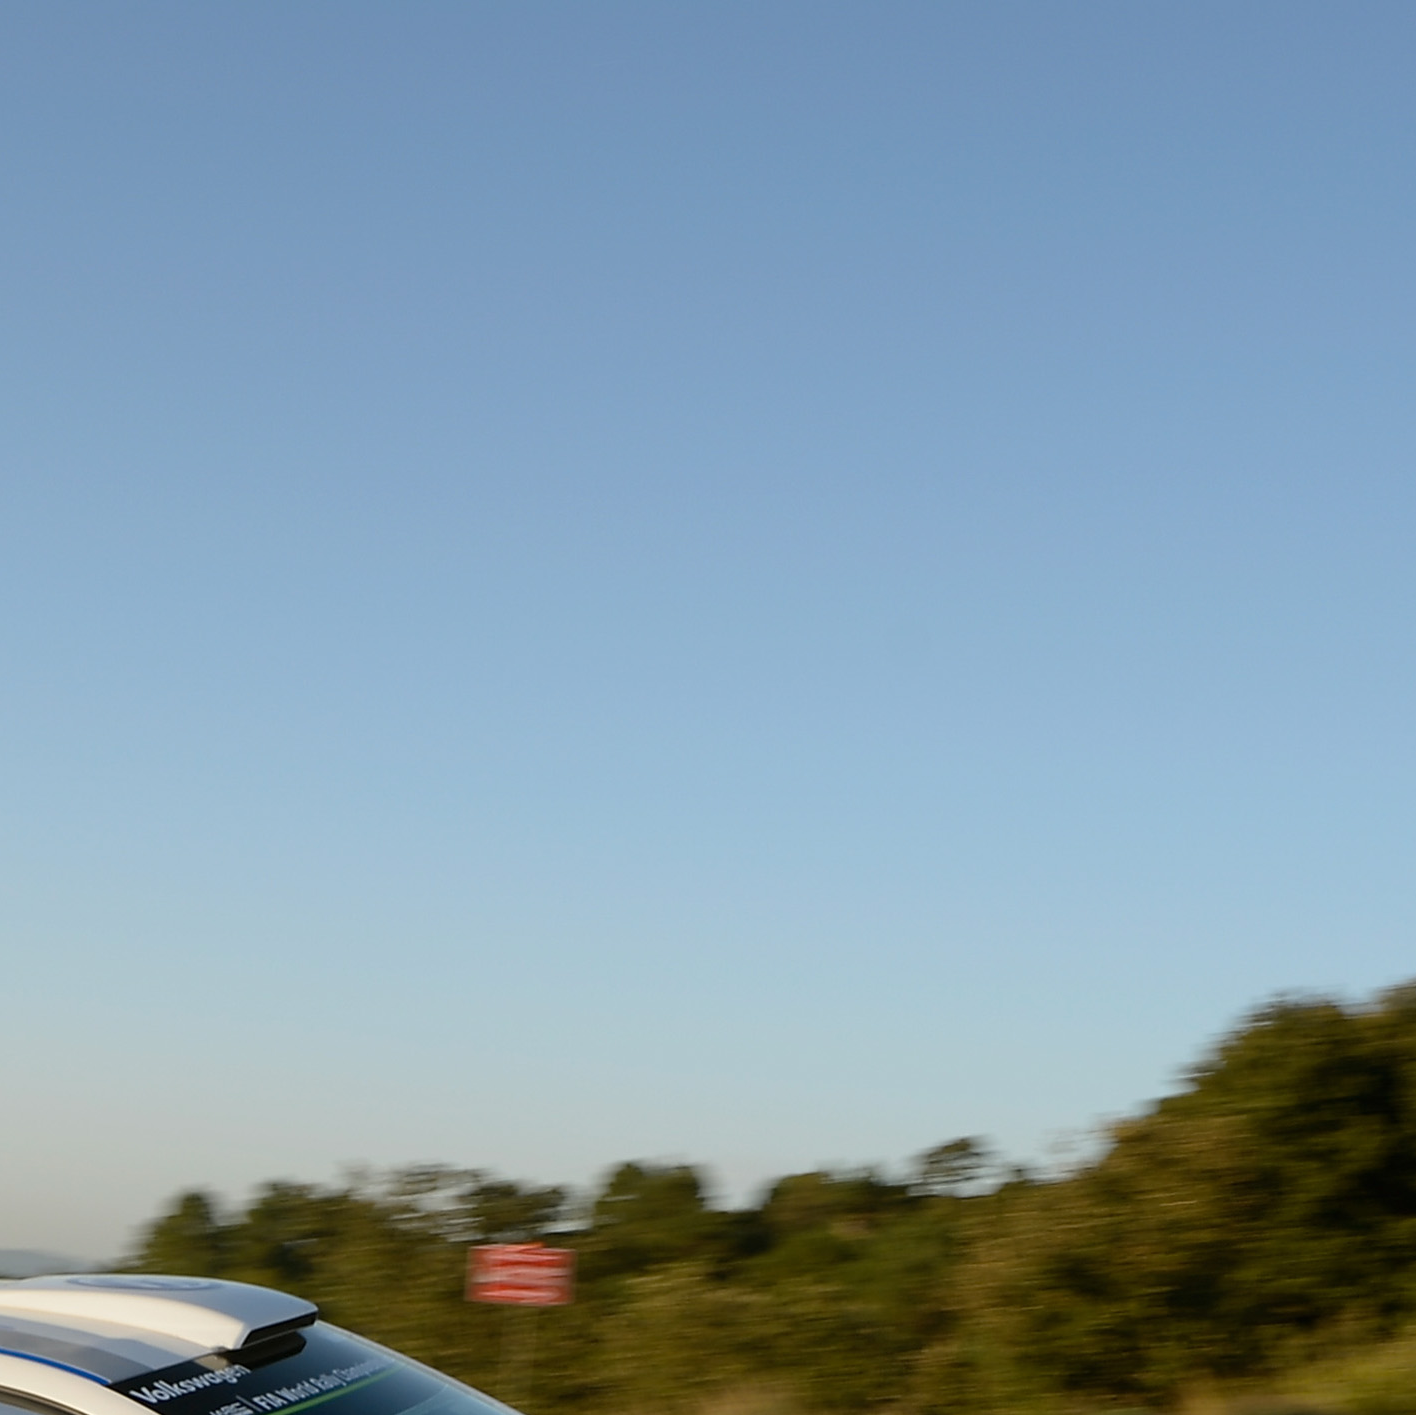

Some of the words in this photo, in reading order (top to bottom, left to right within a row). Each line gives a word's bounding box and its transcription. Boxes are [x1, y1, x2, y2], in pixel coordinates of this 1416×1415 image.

[133, 1362, 251, 1405] Volkswagen
[252, 1391, 289, 1411] FIA
[275, 1379, 320, 1403] World
